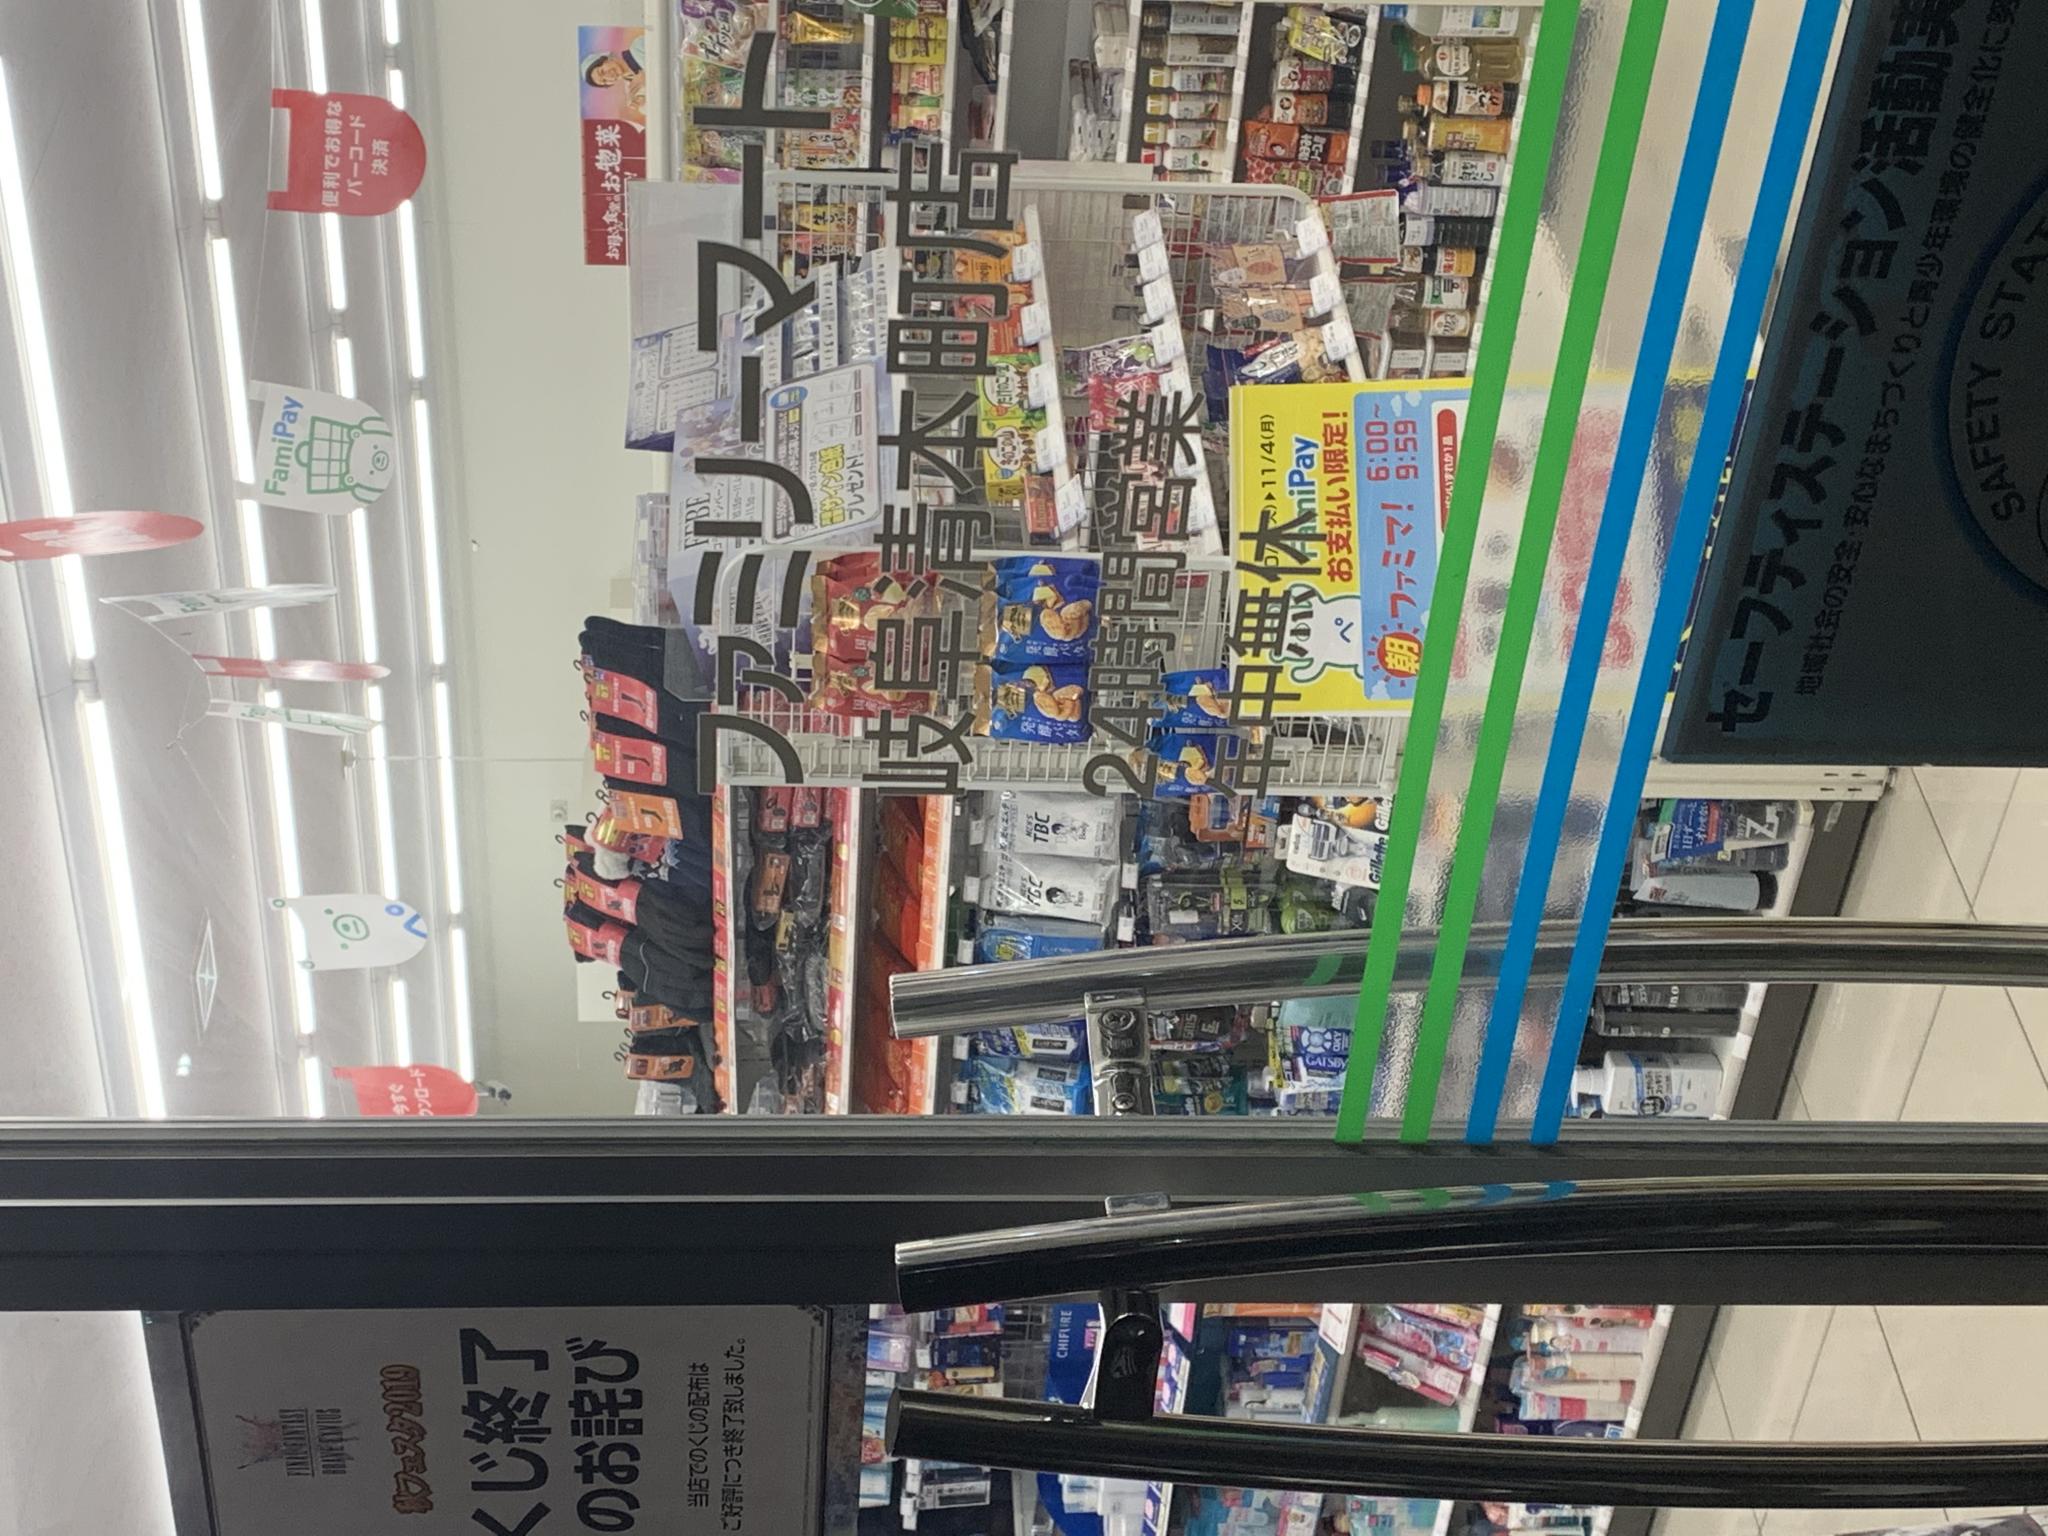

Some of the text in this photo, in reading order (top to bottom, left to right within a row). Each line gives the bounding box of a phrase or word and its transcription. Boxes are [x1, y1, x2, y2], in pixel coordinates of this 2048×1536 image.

[321, 100, 343, 207] 便利でお得な
[347, 114, 365, 197] バーコード
[371, 139, 390, 176] 決済
[264, 396, 303, 495] FamiPay
[691, 30, 832, 796] ファミリーマート
[864, 139, 1020, 798] 岐阜清本町店
[1392, 418, 1420, 480] 9:59
[1965, 361, 2028, 521] SAFETY
[846, 452, 866, 521] プレゼント!
[1323, 410, 1355, 584] お支払い限定!
[1082, 387, 1201, 800] 24時間営業
[1210, 509, 1327, 798] 年中無休
[1380, 502, 1421, 673] 朝 ファミマ!
[1033, 810, 1050, 843] TBC
[1367, 836, 1390, 884] Gillette
[388, 1083, 410, 1115] 今すぐ
[1333, 1030, 1342, 1052] OXY
[283, 1449, 311, 1477] FINAL
[379, 1363, 434, 1514] 秋フェスタ2019
[459, 1327, 551, 1536] くじ終了
[565, 1336, 644, 1533] のお詫び
[687, 1361, 711, 1507] 当店でのくじの配布は
[720, 1337, 746, 1531] ご好評につき終了致しました。
